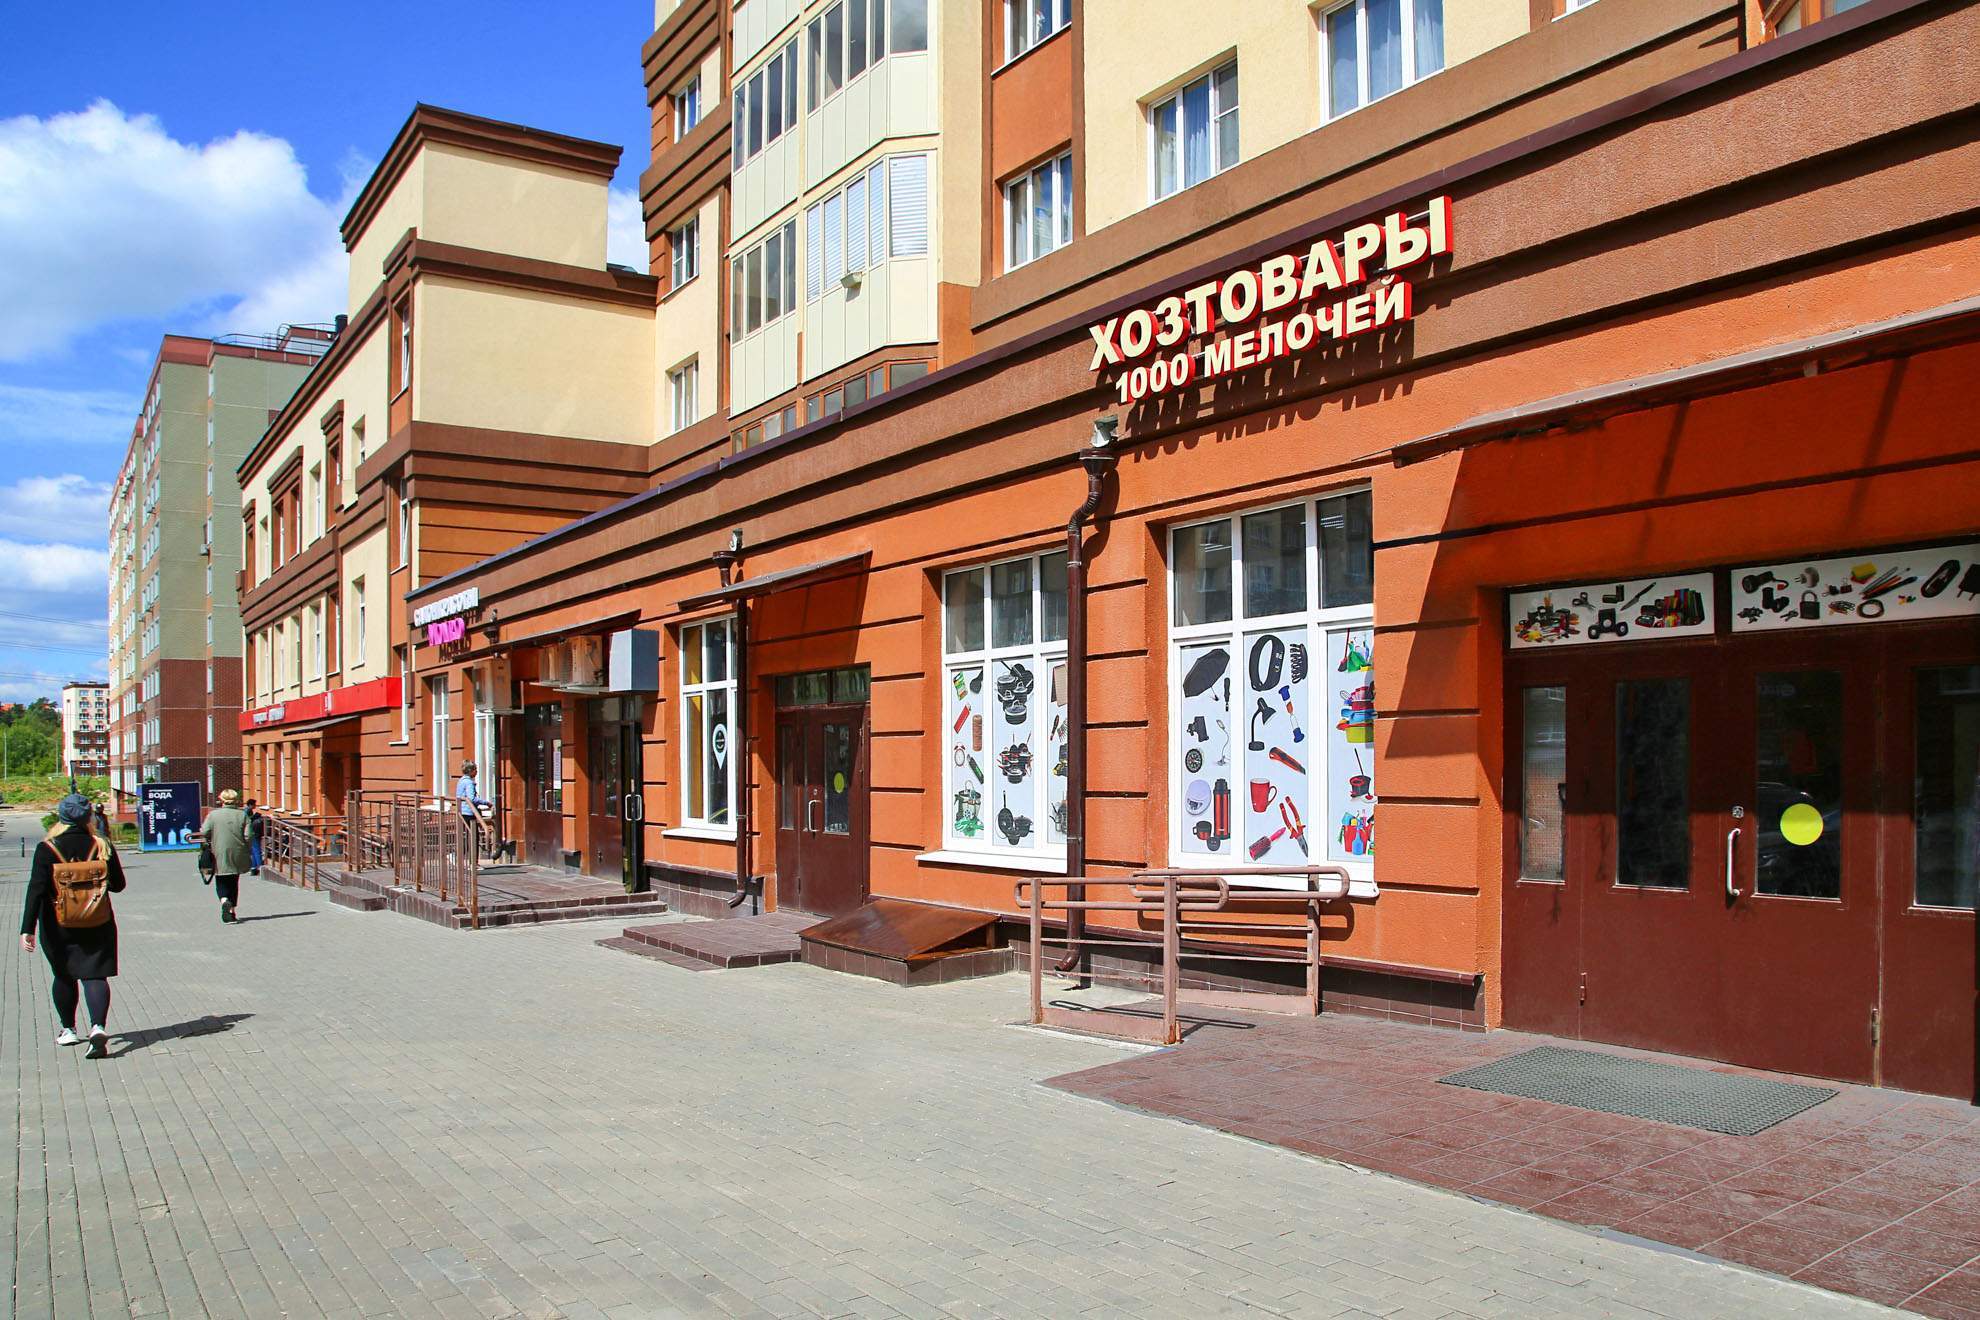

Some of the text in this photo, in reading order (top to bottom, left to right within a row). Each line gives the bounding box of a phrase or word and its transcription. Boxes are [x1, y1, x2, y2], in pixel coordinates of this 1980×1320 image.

[1088, 195, 1452, 371] ХОЗТОВАРЫ
[1115, 274, 1412, 404] 1000 МЕЛОЧЕЙ
